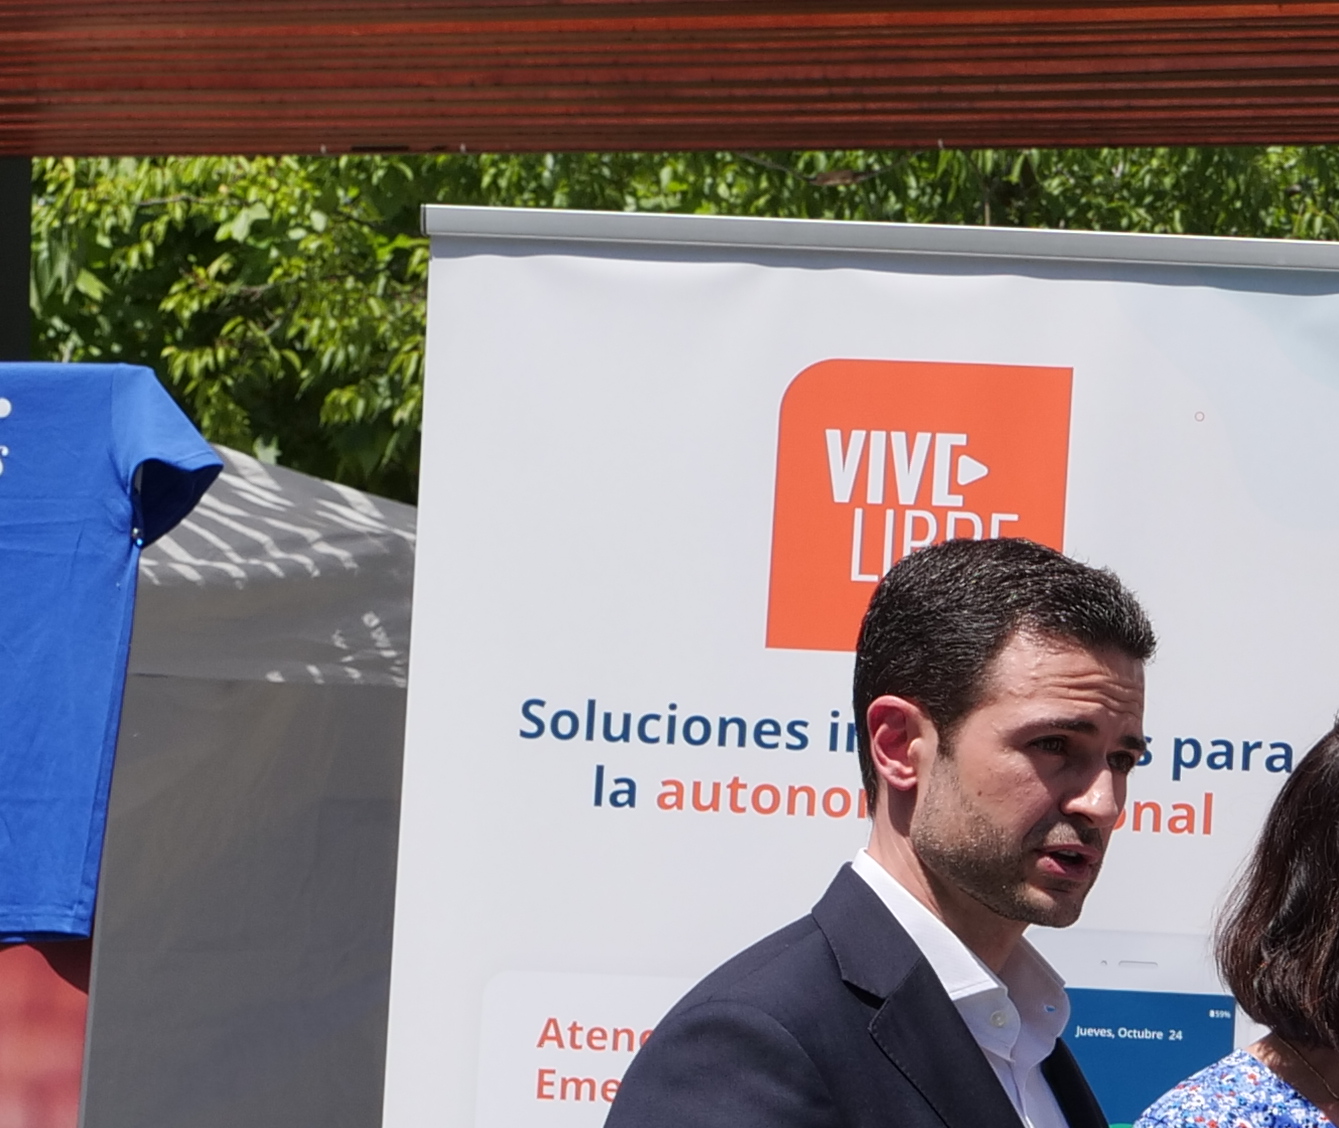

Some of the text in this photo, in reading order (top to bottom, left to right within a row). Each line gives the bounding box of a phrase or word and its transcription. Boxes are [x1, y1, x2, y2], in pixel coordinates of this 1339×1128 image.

[825, 428, 968, 507] VIVE
[519, 698, 810, 752] Soluciones
[1172, 735, 1294, 782] para
[593, 763, 637, 809] la
[656, 775, 868, 819] autono
[1074, 1024, 1184, 1042] Jueves, Octubre 24
